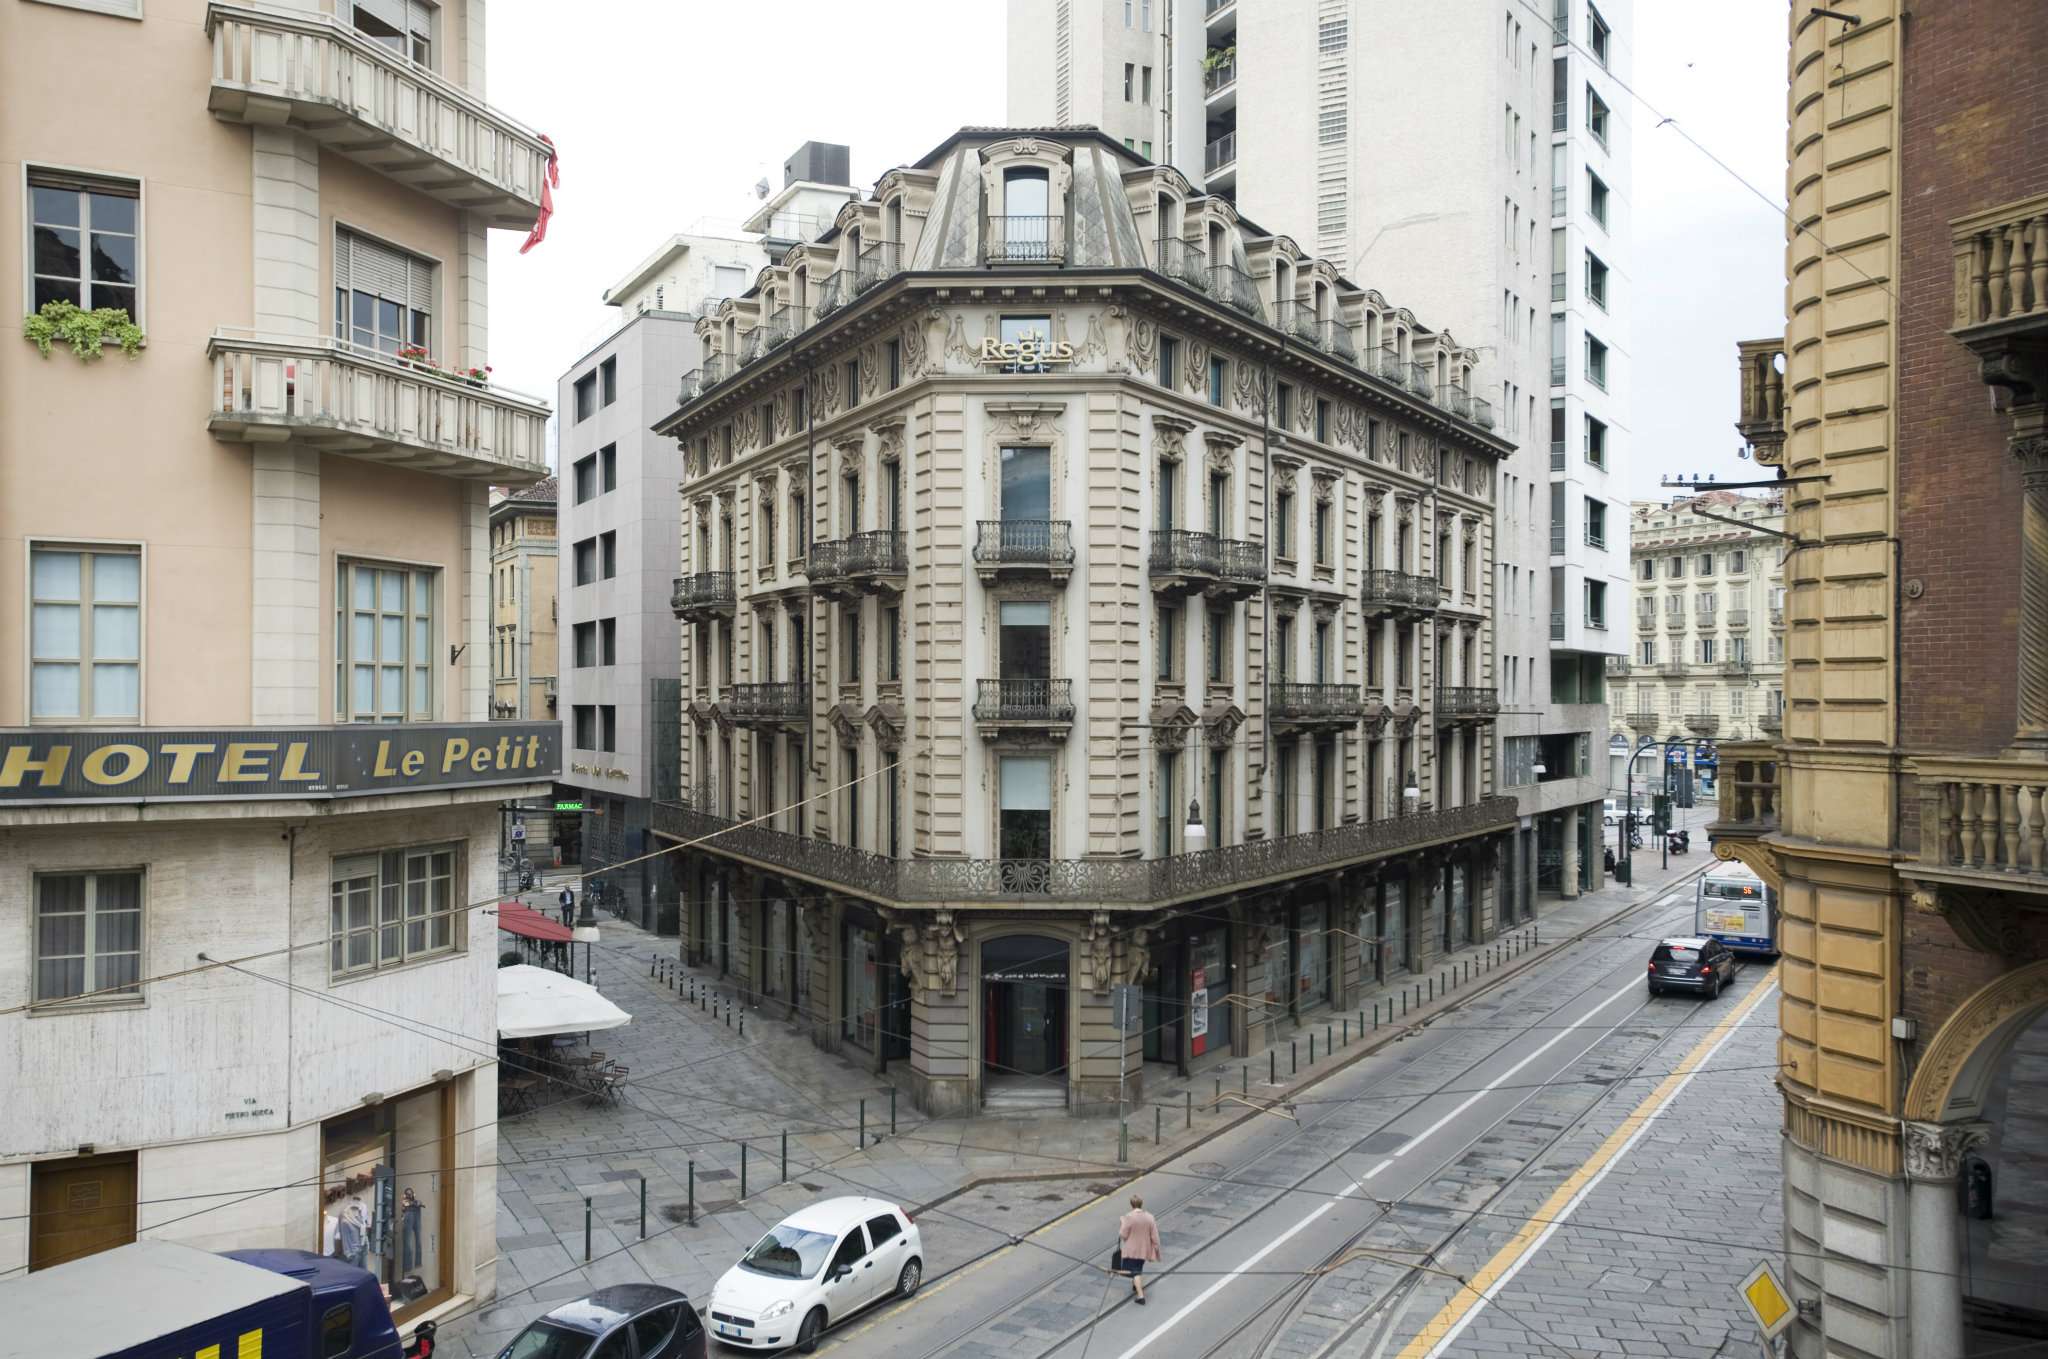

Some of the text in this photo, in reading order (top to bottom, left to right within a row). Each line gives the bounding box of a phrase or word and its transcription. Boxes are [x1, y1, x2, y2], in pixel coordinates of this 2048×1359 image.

[980, 336, 1074, 365] Regus
[0, 742, 321, 788] HOTEL
[373, 740, 425, 777] Le
[441, 735, 540, 774] Petit
[1743, 886, 1752, 894] 56
[243, 1097, 257, 1105] VIA
